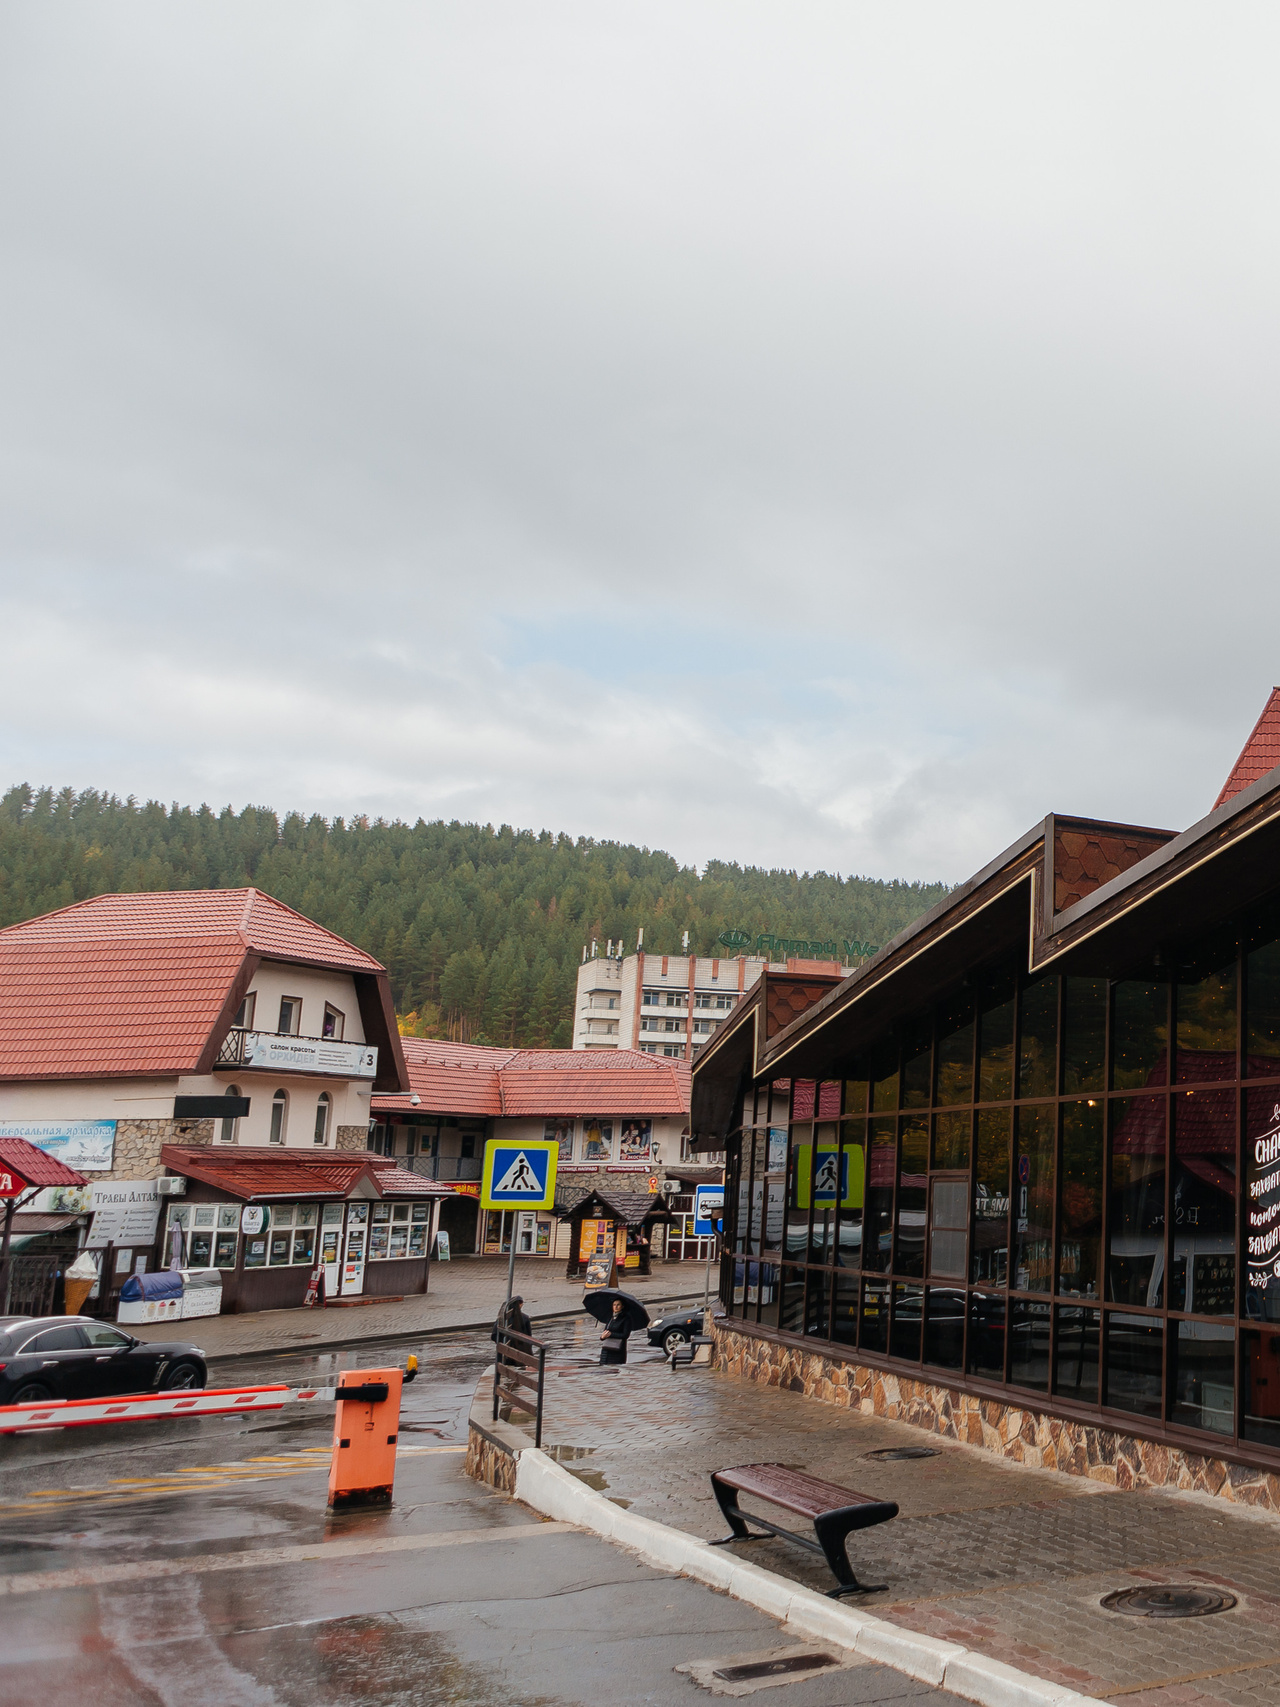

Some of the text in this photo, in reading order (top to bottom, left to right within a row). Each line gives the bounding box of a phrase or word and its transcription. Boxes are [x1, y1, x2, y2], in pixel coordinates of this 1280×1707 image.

[270, 1043, 289, 1051] салон
[290, 1046, 316, 1054] красоты
[269, 1051, 315, 1064] ОРХИДЕЯ
[366, 1054, 374, 1066] 3
[0, 1126, 112, 1138] версальная ярмарка
[0, 1173, 13, 1190] А
